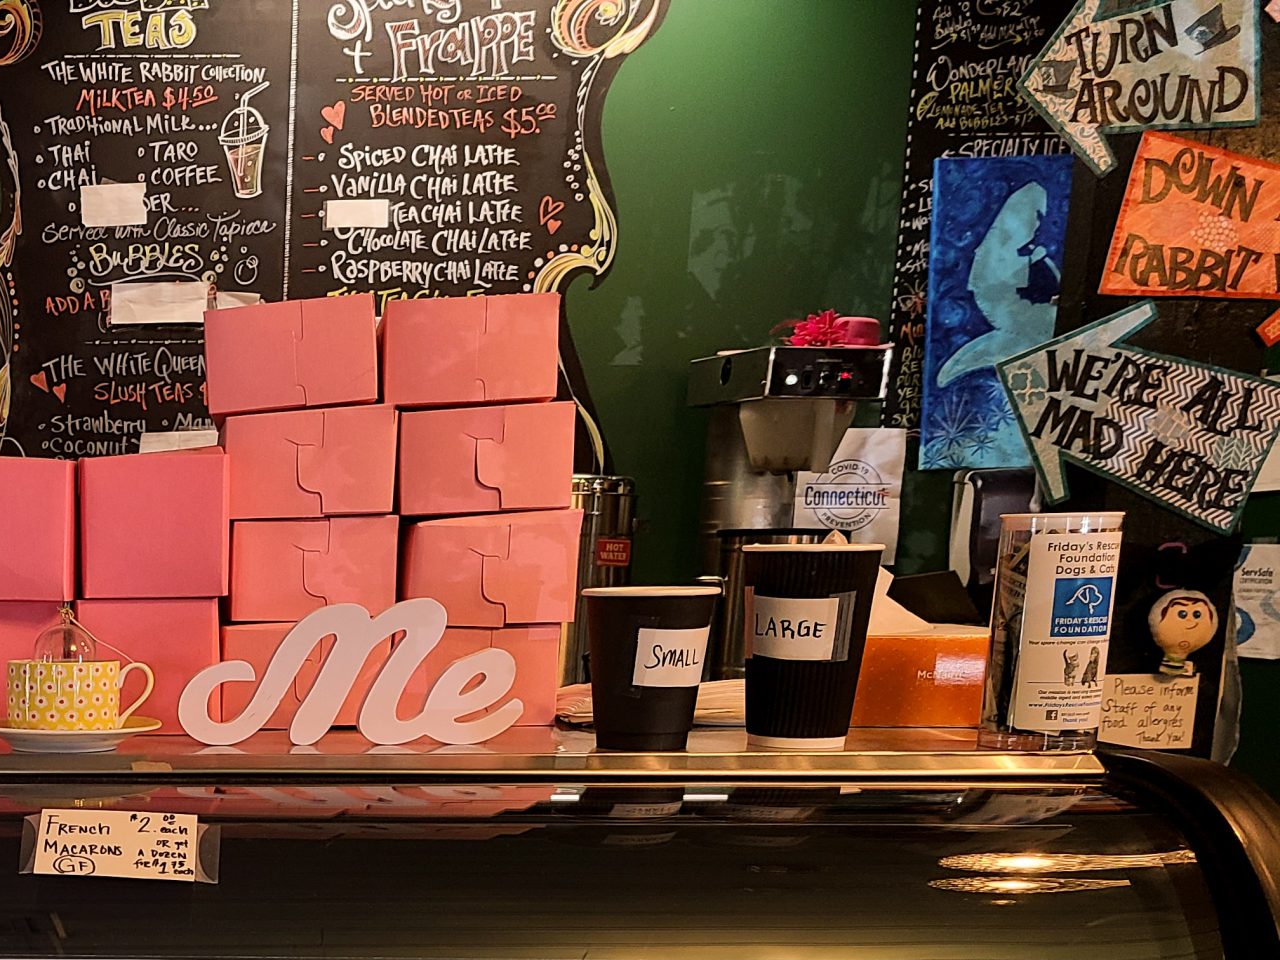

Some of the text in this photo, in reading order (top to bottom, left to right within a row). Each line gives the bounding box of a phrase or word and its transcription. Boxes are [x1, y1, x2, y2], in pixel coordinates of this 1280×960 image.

[82, 9, 196, 51] TEAS
[1064, 4, 1179, 78] TURN
[41, 60, 79, 84] THE
[81, 61, 133, 84] WHITE
[140, 62, 200, 84] RABBIT
[122, 89, 156, 112] TEA
[350, 85, 415, 103] SERVED
[419, 86, 453, 105] HOT
[476, 85, 523, 104] ICED
[1069, 65, 1249, 127] AROUND
[370, 104, 451, 130] BLENDED
[450, 107, 495, 133] TEAS
[149, 141, 199, 162] TARO
[464, 144, 520, 170] LATTE
[959, 138, 1039, 159] SPECIALTY
[150, 165, 222, 186] COFFEE
[462, 171, 519, 197] LATTE
[1138, 146, 1264, 223] DOWN
[390, 201, 420, 229] TEA
[468, 199, 523, 226] LATTE
[153, 217, 210, 241] Classic
[207, 210, 276, 242] Tapioca
[477, 230, 532, 254] LATTE
[1112, 232, 1262, 291] RABBIT
[471, 259, 520, 289] LATTE
[46, 296, 79, 316] ADD
[83, 297, 96, 311] A
[42, 355, 87, 382] THE
[94, 382, 147, 410] SLUSH
[149, 383, 193, 404] TEAS
[1045, 348, 1270, 438] WE'RE ALL
[51, 410, 146, 433] Strawberry
[1030, 396, 1249, 511] MAD HERE
[804, 486, 890, 506] Connecticut
[821, 512, 871, 528] PREVENTION
[606, 543, 624, 551] HOT
[1047, 541, 1093, 553] Friday's
[1059, 553, 1115, 563] Foundation
[1055, 565, 1086, 576] Dogs
[1089, 566, 1096, 574] &
[1241, 567, 1274, 577] ServSafe
[754, 612, 829, 639] LARGE
[1054, 626, 1107, 634] FOUNDATION
[1055, 617, 1089, 625] FRIDAY'S
[644, 644, 699, 669] SMALL
[178, 597, 524, 746] Me
[1114, 678, 1154, 696] Please
[1101, 698, 1138, 716] Staff
[1144, 701, 1157, 715] of
[1163, 703, 1181, 718] any
[1102, 716, 1127, 732] food
[160, 826, 188, 834] each
[44, 838, 123, 856] MACARONS
[138, 849, 187, 859] A DOZEN
[156, 839, 188, 849] OR get
